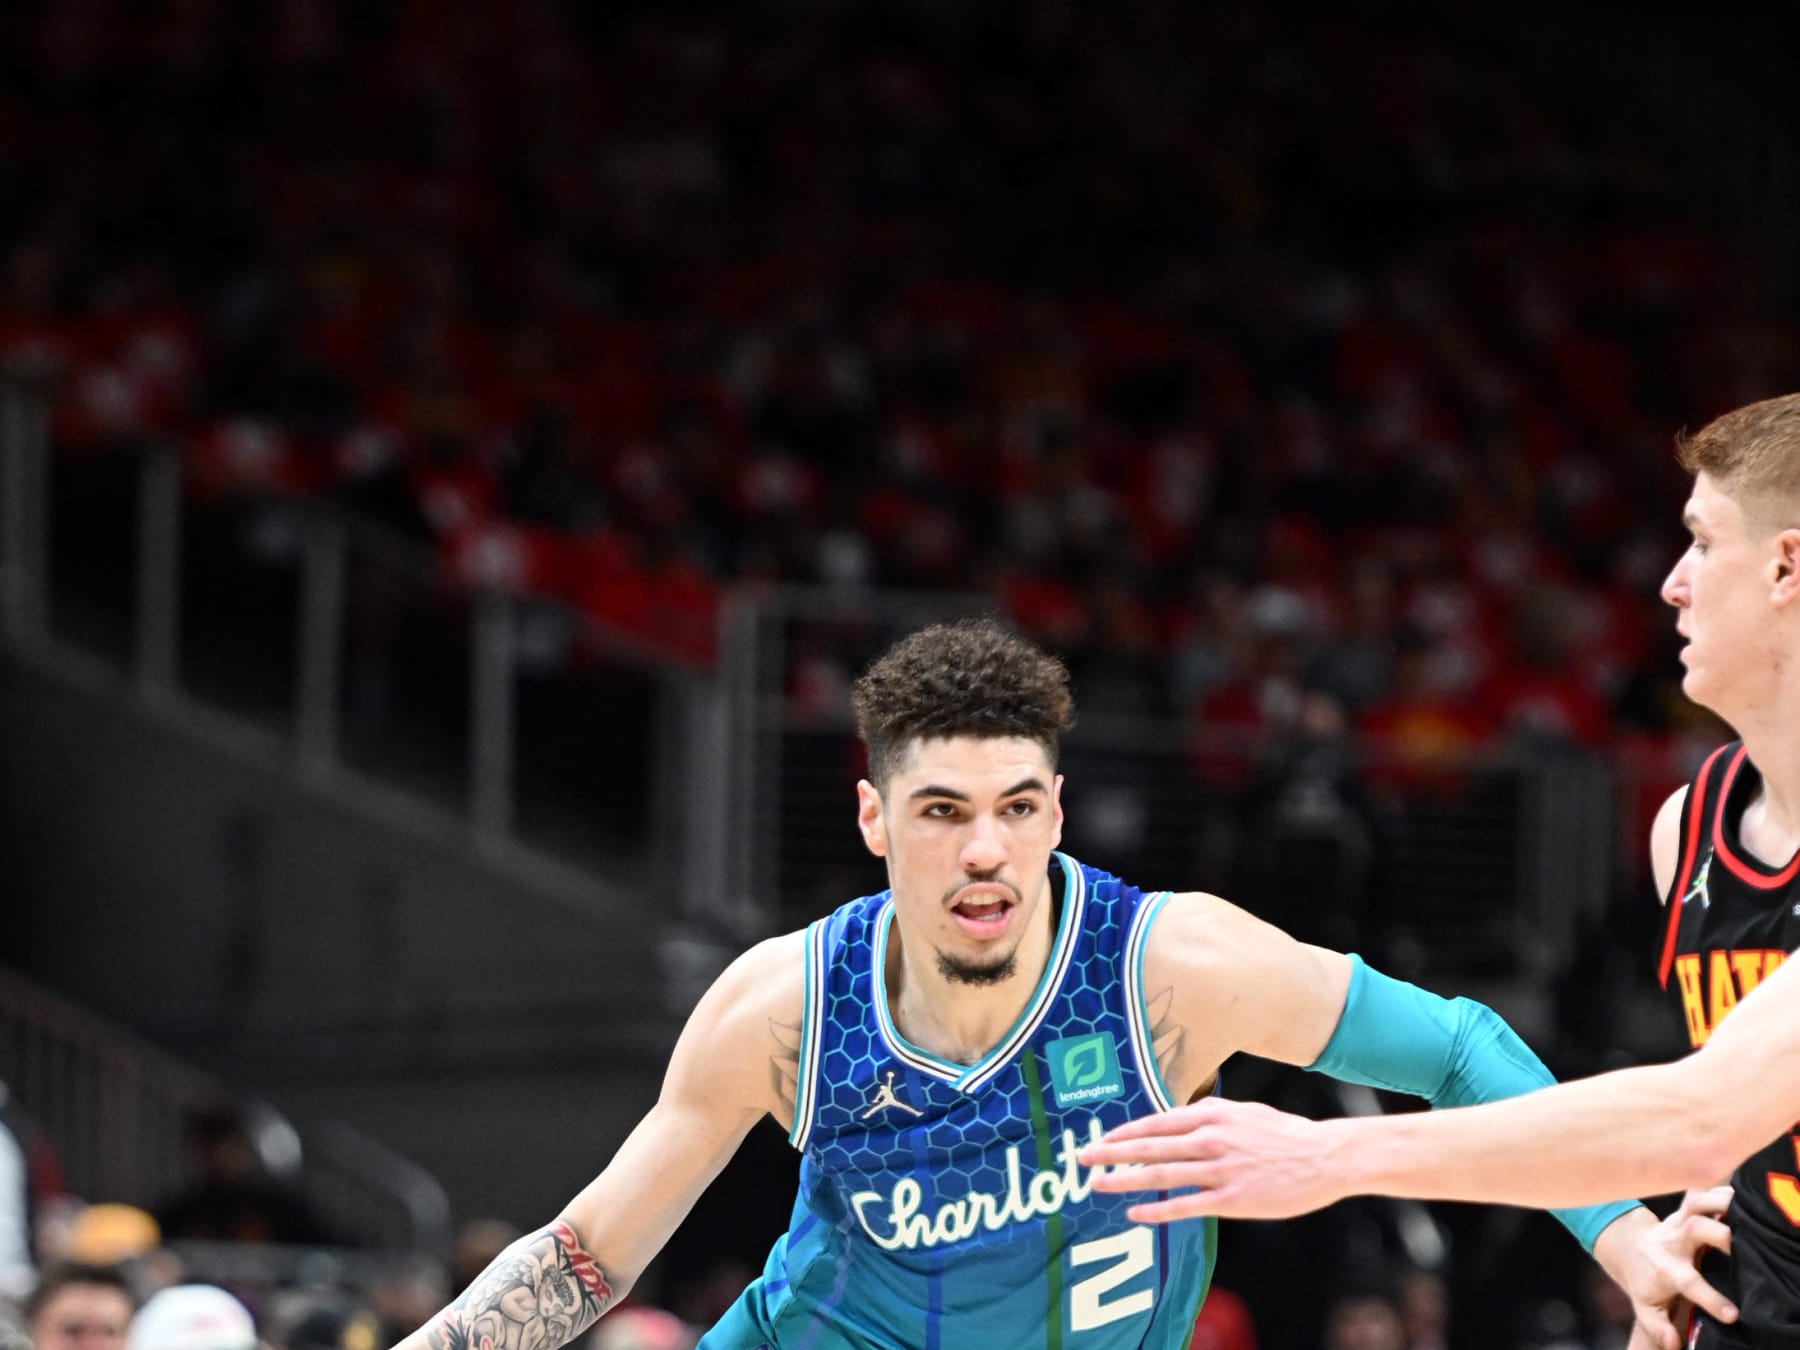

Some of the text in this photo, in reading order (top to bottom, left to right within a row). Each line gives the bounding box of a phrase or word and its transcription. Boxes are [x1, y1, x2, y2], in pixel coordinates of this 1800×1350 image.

[1060, 1083, 1119, 1102] lendingtree
[853, 1116, 1149, 1250] Charlot
[1070, 1226, 1154, 1333] 2
